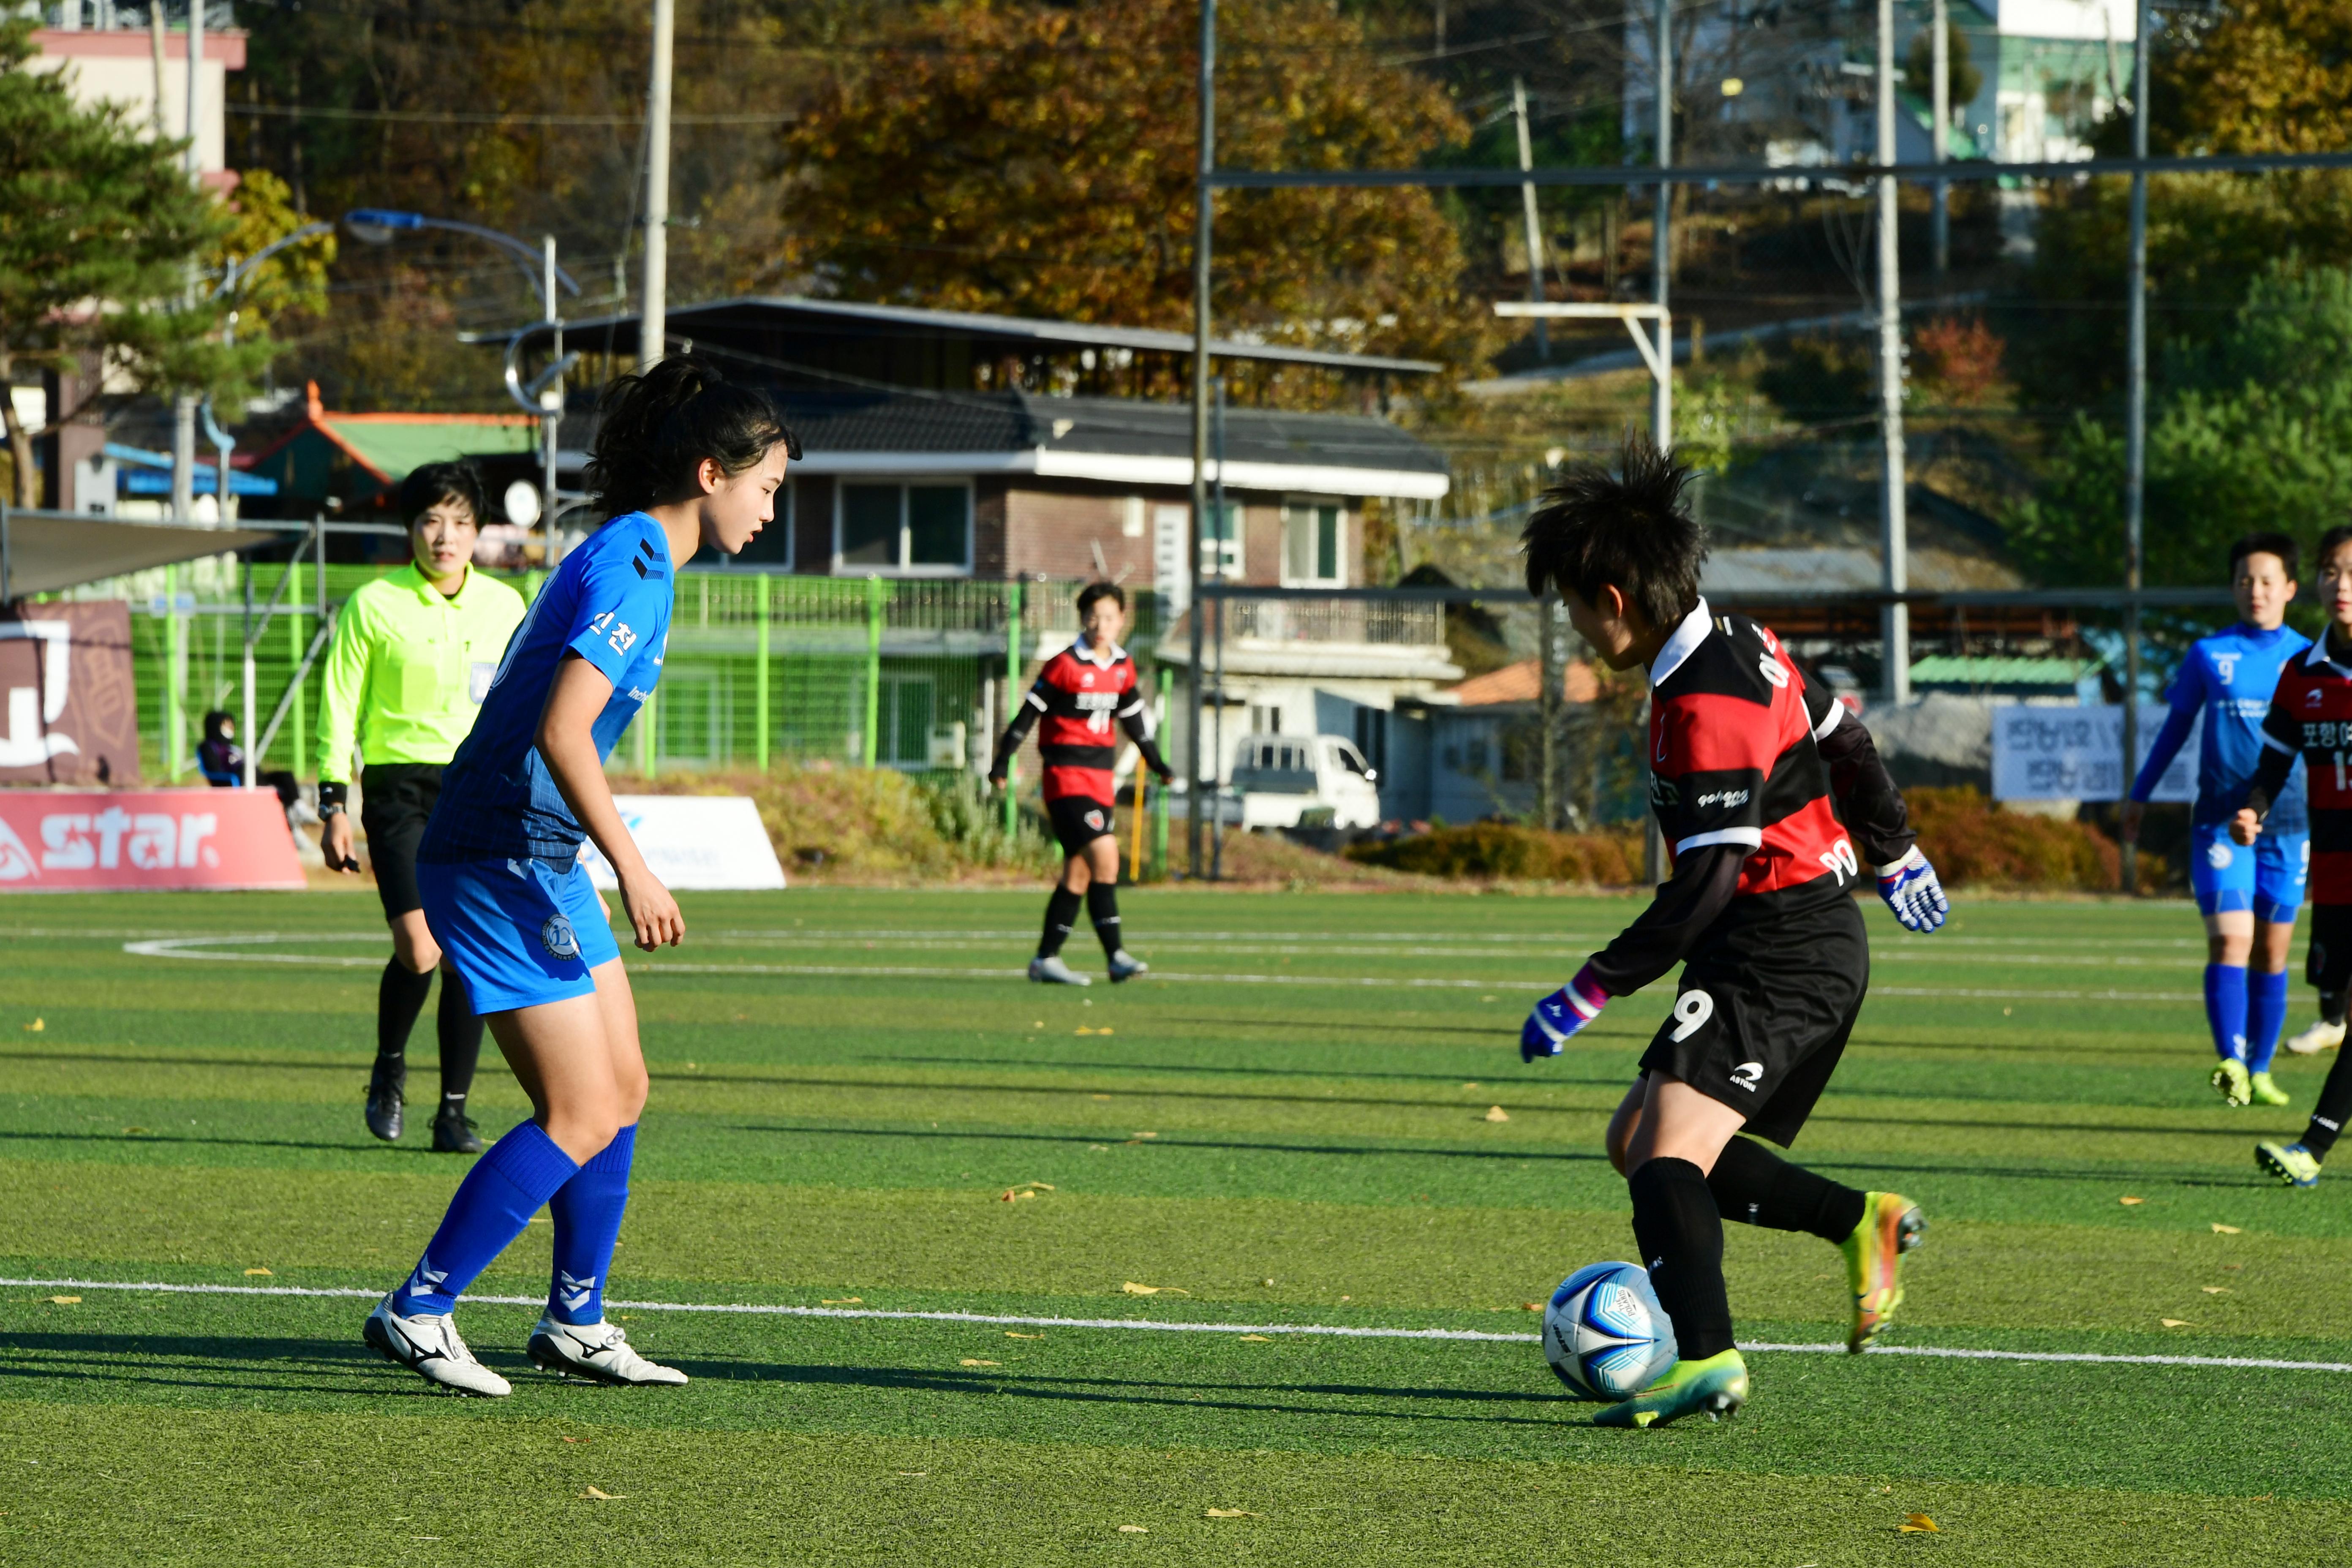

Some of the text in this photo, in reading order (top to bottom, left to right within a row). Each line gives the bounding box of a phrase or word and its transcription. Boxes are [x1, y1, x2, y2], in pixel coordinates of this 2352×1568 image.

[589, 612, 637, 657] 인천
[2219, 660, 2234, 686] 9
[1668, 989, 1714, 1043] 9
[1615, 1298, 1624, 1312] THE
[1617, 1289, 1637, 1317] POLARIS
